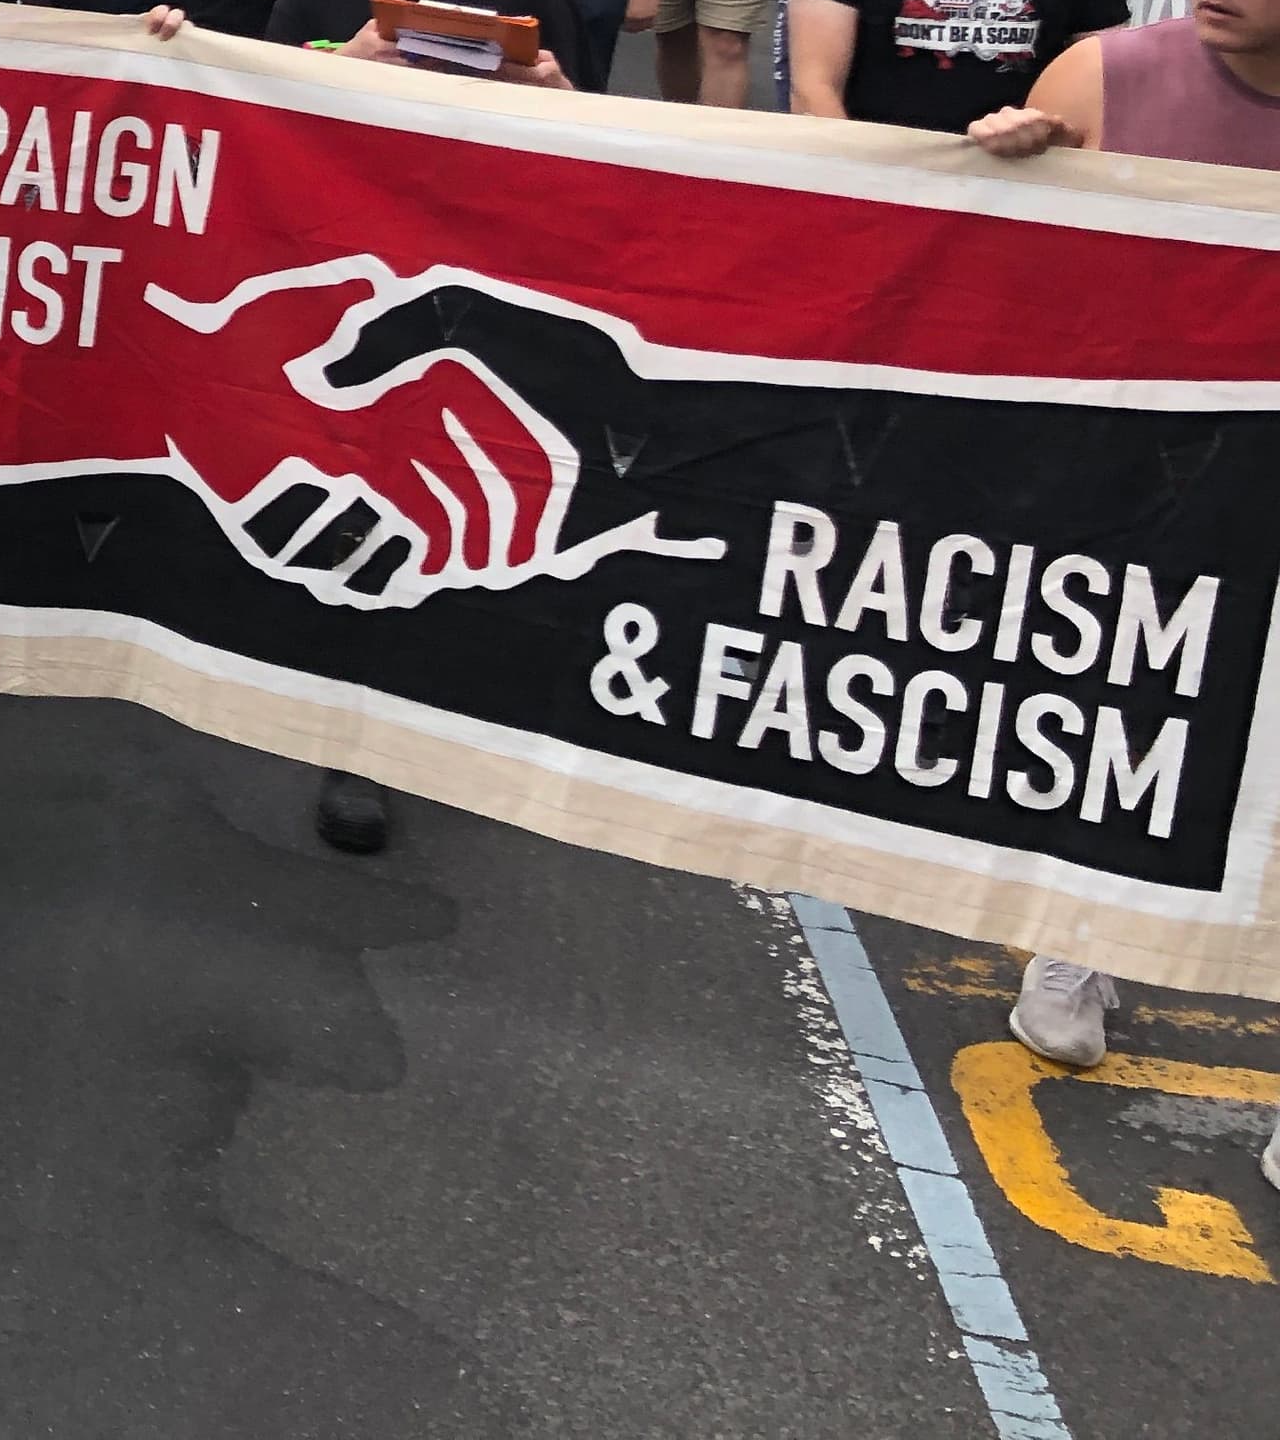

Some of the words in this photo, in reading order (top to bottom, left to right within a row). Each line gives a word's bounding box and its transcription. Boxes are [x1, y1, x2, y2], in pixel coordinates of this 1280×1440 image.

[949, 26, 970, 43] BE
[972, 26, 983, 44] A
[986, 26, 1036, 45] SCAB!
[757, 499, 1221, 700] RACISM
[589, 601, 671, 726] &
[690, 622, 1190, 840] FASCISM
